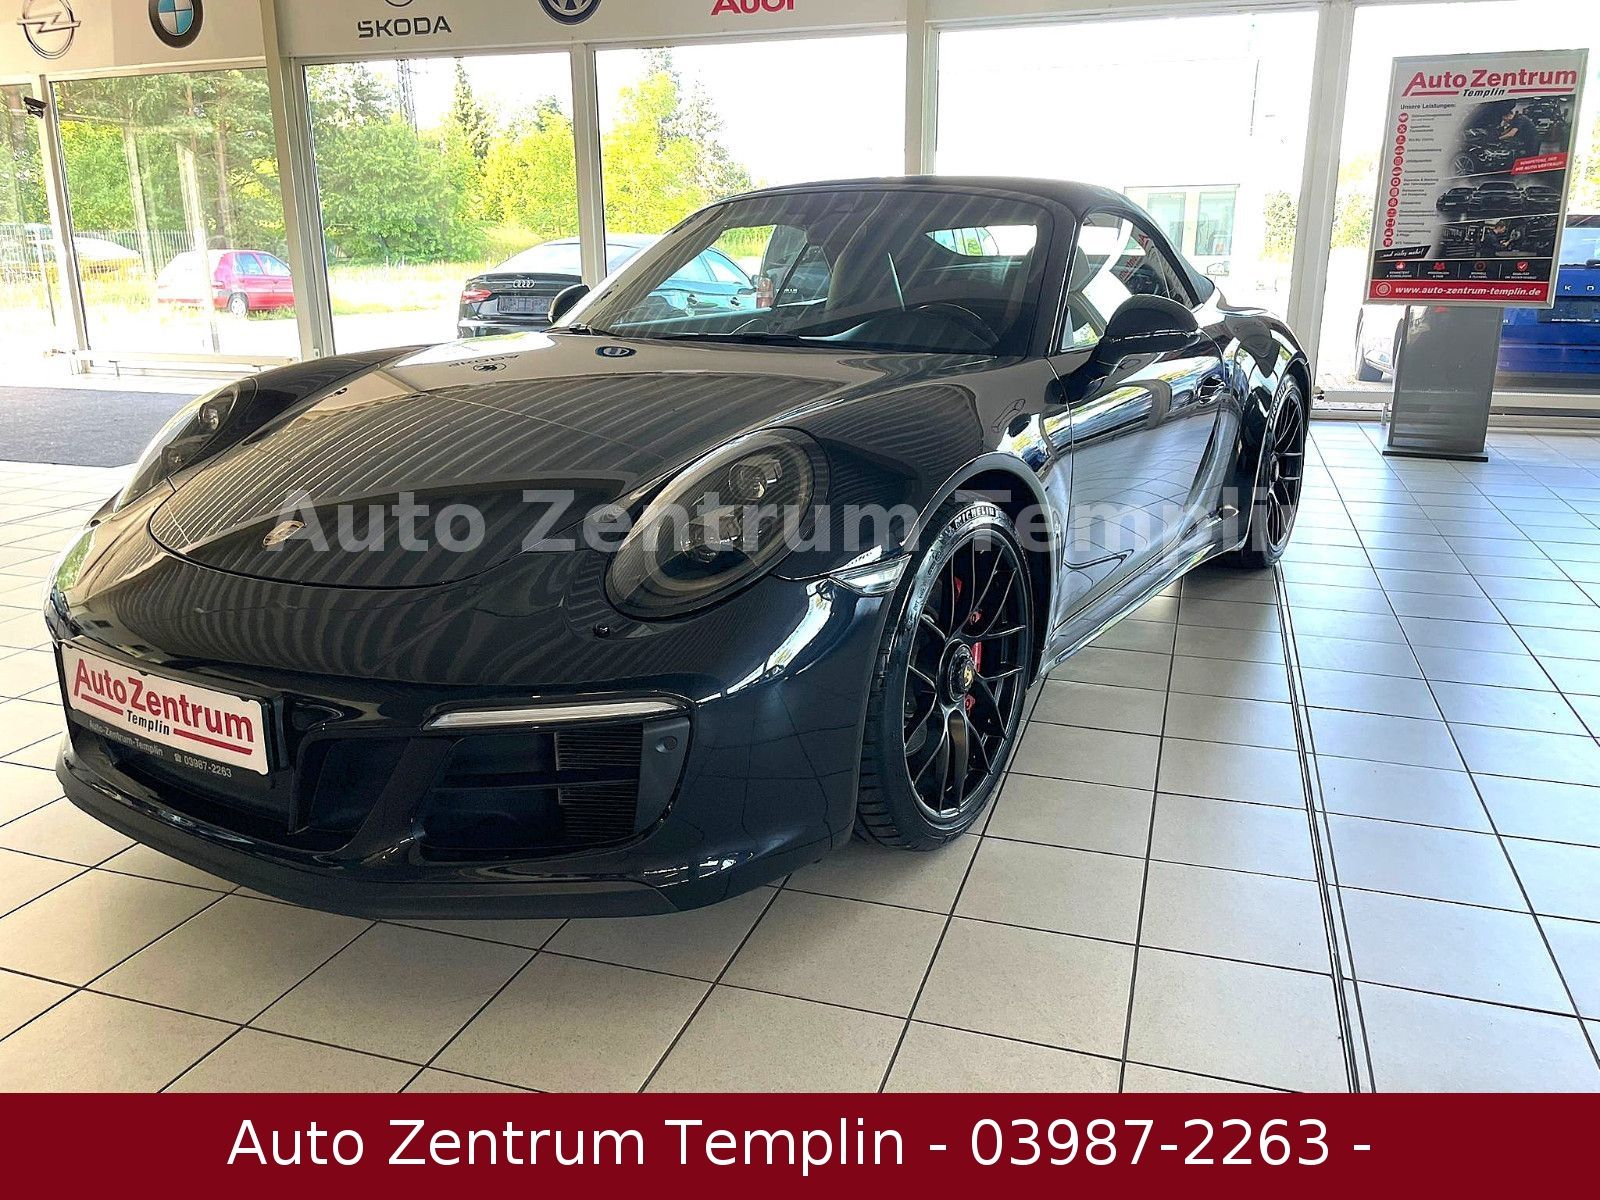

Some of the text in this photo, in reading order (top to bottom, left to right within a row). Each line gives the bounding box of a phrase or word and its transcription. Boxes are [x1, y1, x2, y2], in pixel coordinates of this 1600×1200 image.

[1402, 68, 1577, 97] Auto Zentrum
[1462, 88, 1505, 98] Templin
[1395, 286, 1541, 297] www.auto-zentrum-templin.de
[127, 709, 170, 736] Templin
[183, 755, 232, 778] 03987-2263
